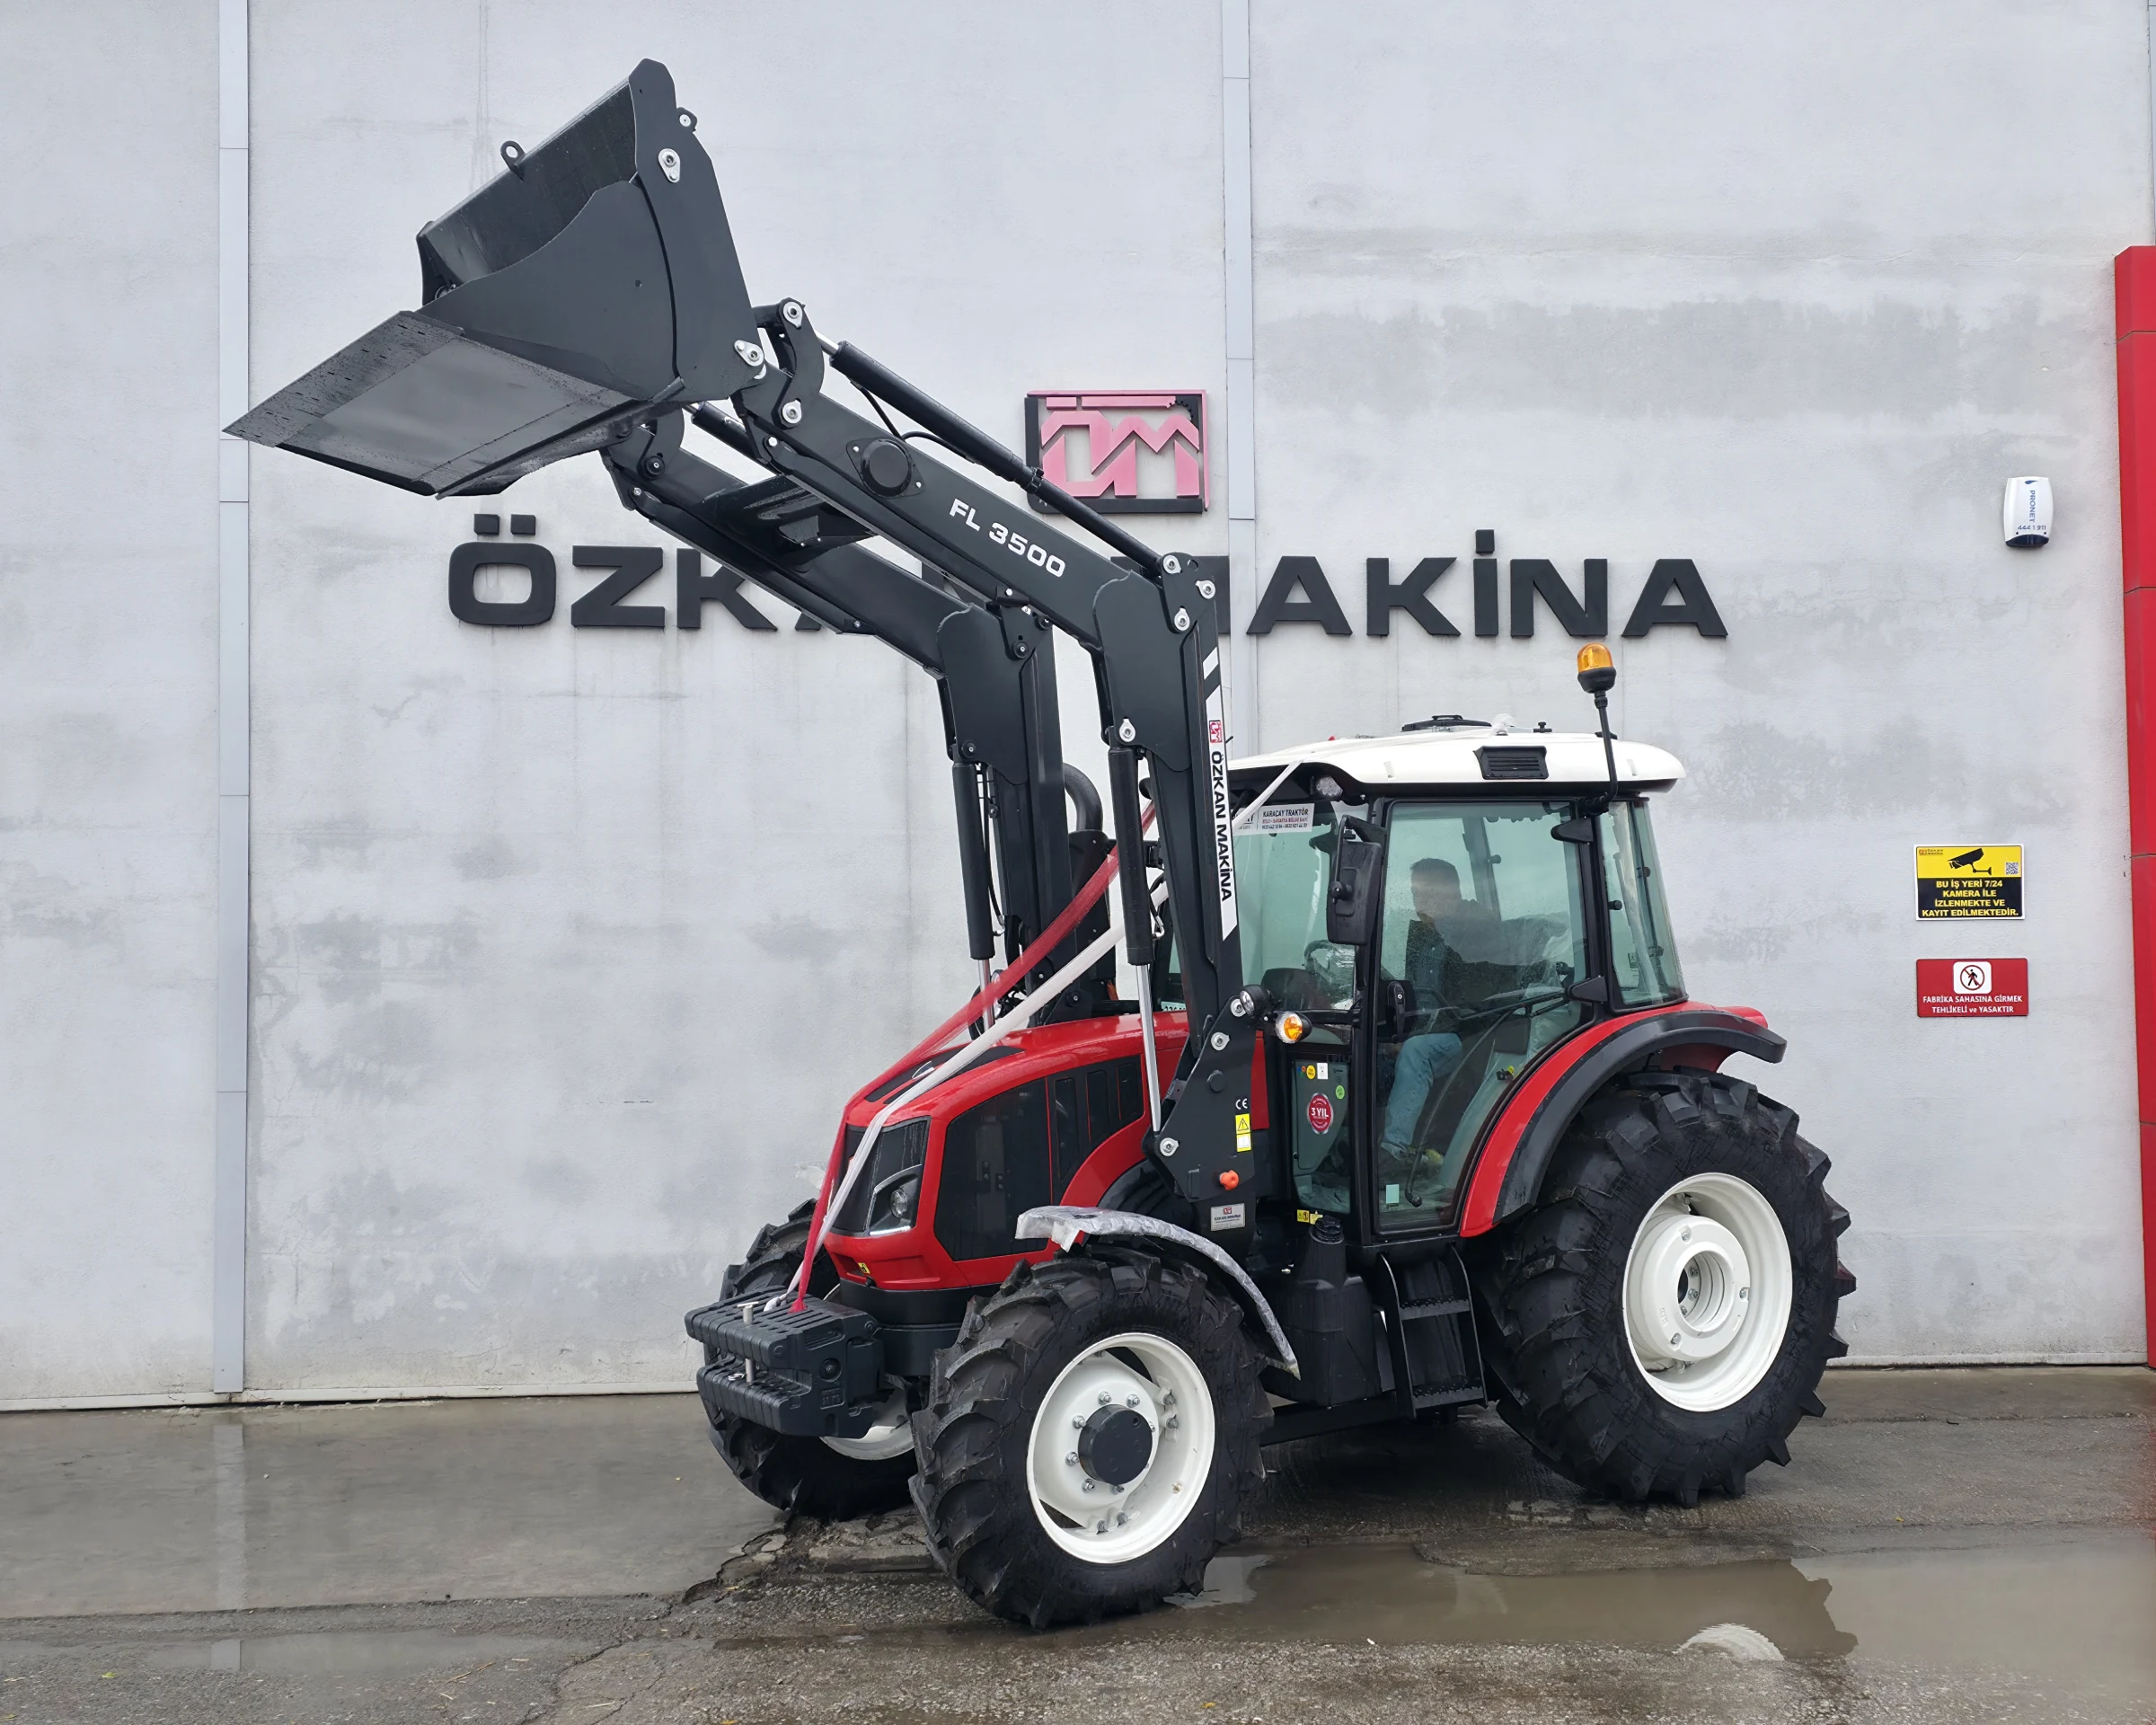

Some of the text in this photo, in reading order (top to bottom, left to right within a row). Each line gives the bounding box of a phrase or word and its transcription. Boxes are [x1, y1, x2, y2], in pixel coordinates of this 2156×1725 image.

[949, 498, 1066, 578] FL 3500
[1286, 808, 1309, 816] TRAKTÖR
[1211, 751, 1233, 902] ÖZKAN MAKİNA
[1936, 879, 2003, 889] BU İŞ YERİ 7/24
[1942, 889, 1997, 898] KAMERA İLE
[1934, 898, 2005, 907] İZLENMEKTE VE
[1950, 907, 2019, 916] EDİLMEKTEDİR.
[1922, 995, 1954, 1004] FABRİKA
[1994, 994, 2023, 1003] GİRMEK
[1931, 1004, 1968, 1013] TEHLİKELİ
[1978, 1005, 2014, 1013] YASAKTIR
[1311, 1107, 1330, 1118] 3 YIL
